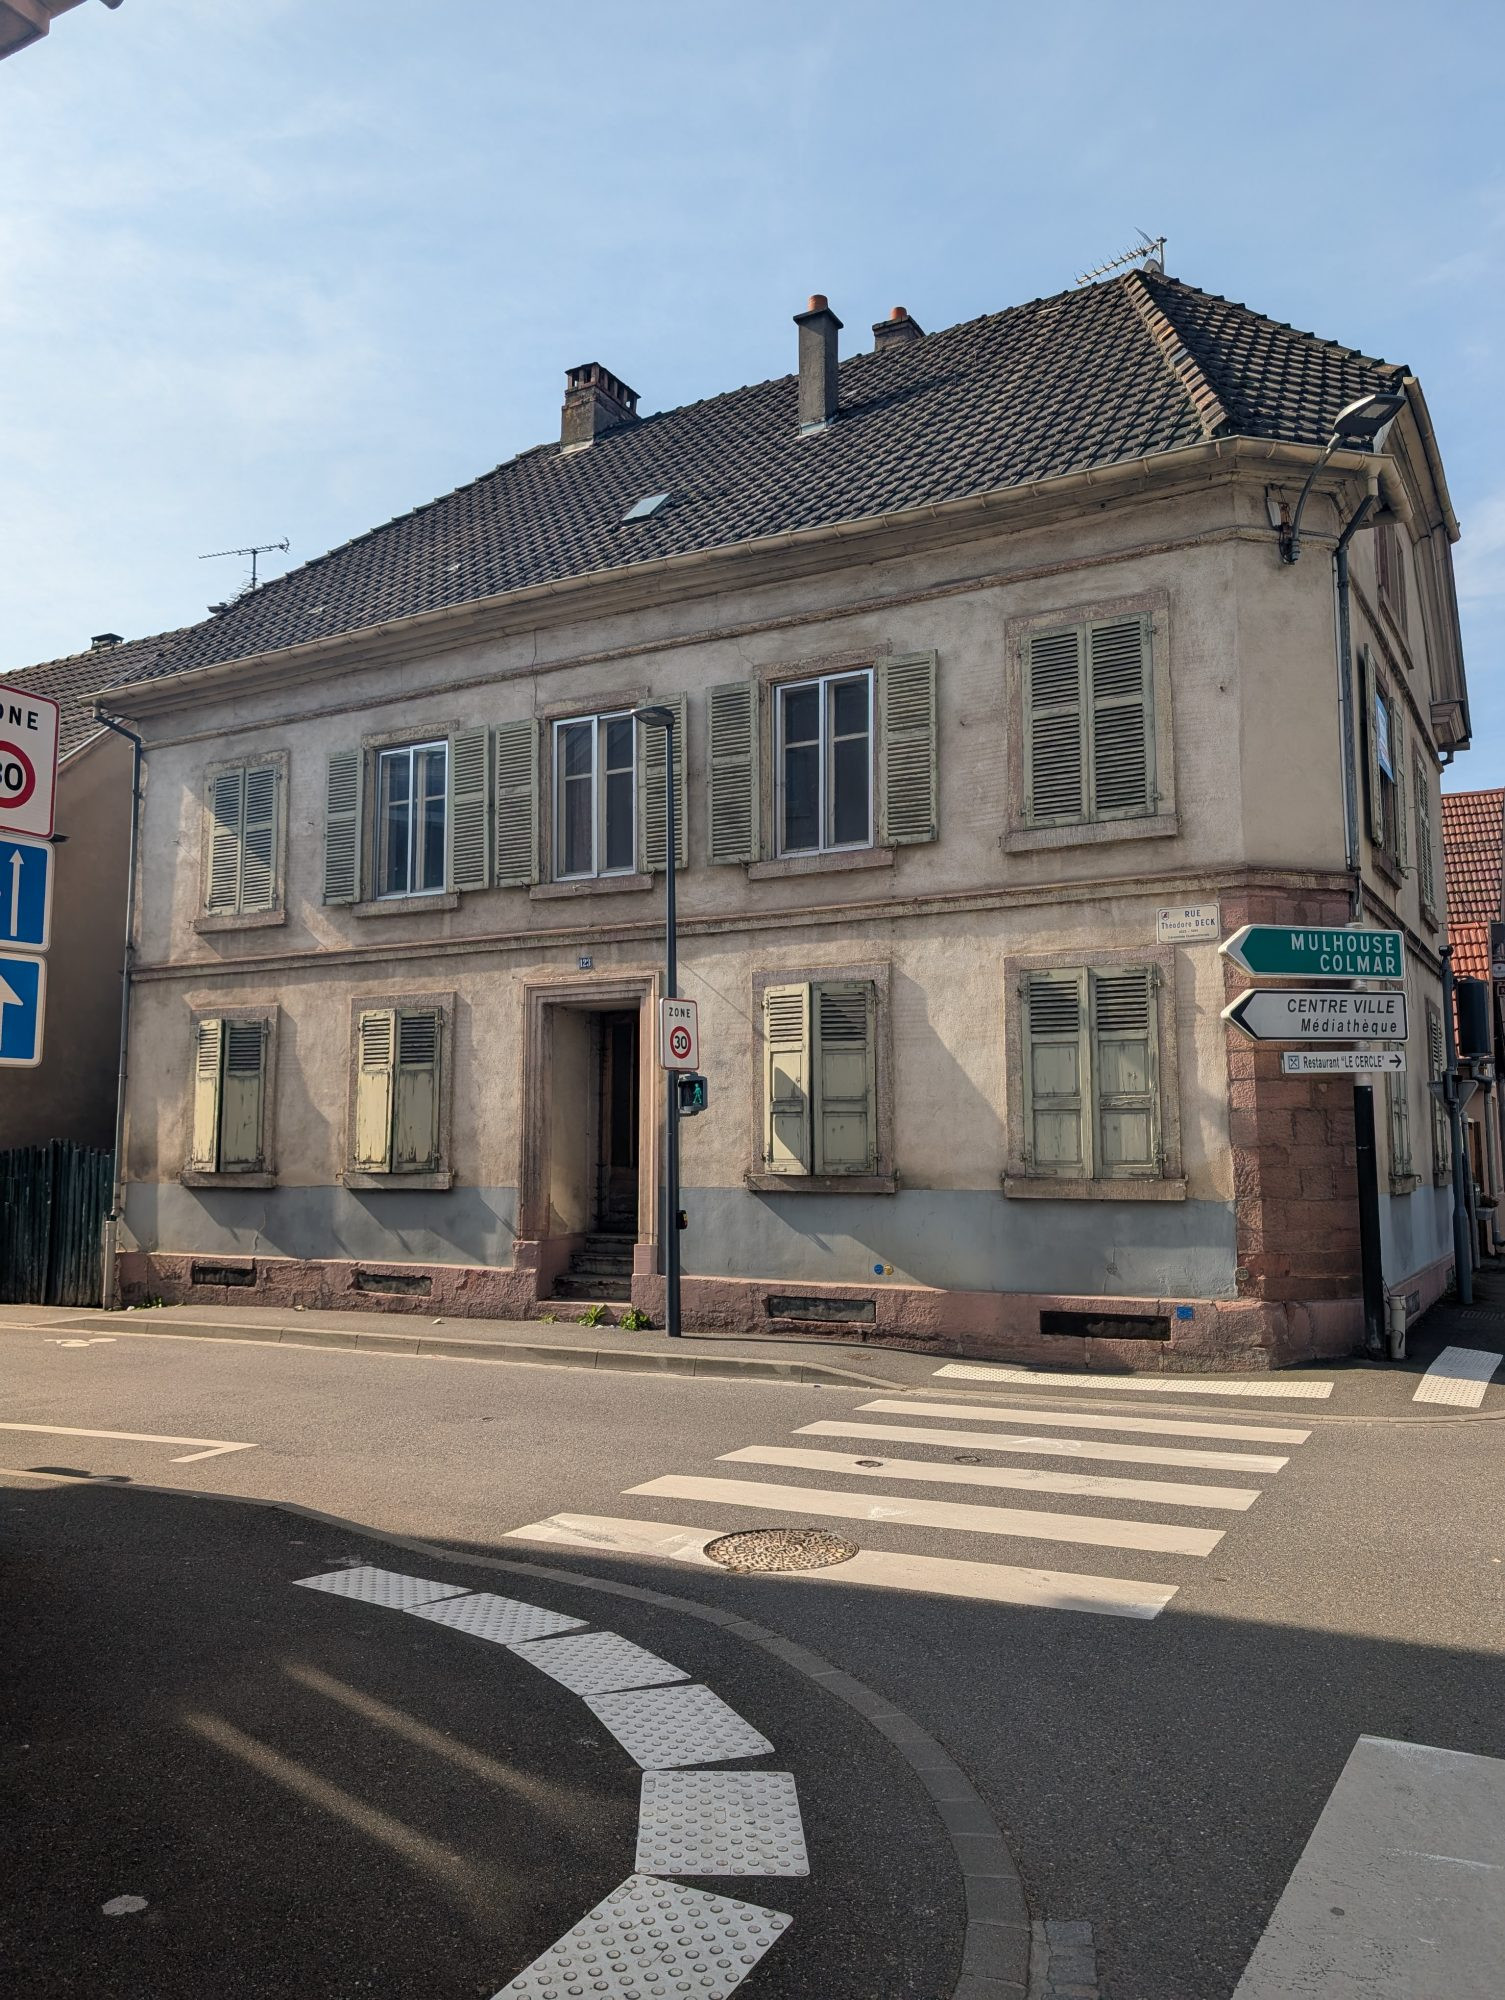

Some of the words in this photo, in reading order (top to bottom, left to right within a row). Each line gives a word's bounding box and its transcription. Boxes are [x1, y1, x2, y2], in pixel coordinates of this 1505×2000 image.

[0, 763, 23, 791] 0
[1184, 910, 1201, 918] RUE
[1161, 921, 1192, 930] Théodore
[1195, 918, 1216, 927] DECK
[1291, 933, 1395, 954] MULHOUSE
[580, 958, 591, 968] 123
[1320, 954, 1395, 973] COLMAR
[668, 1007, 691, 1018] ZONE
[1287, 999, 1348, 1013] CENTRE
[1354, 1000, 1395, 1014] VILLE
[1301, 1018, 1397, 1035] Médiathèque
[674, 1035, 688, 1050] 30
[1303, 1056, 1340, 1069] Restaurant
